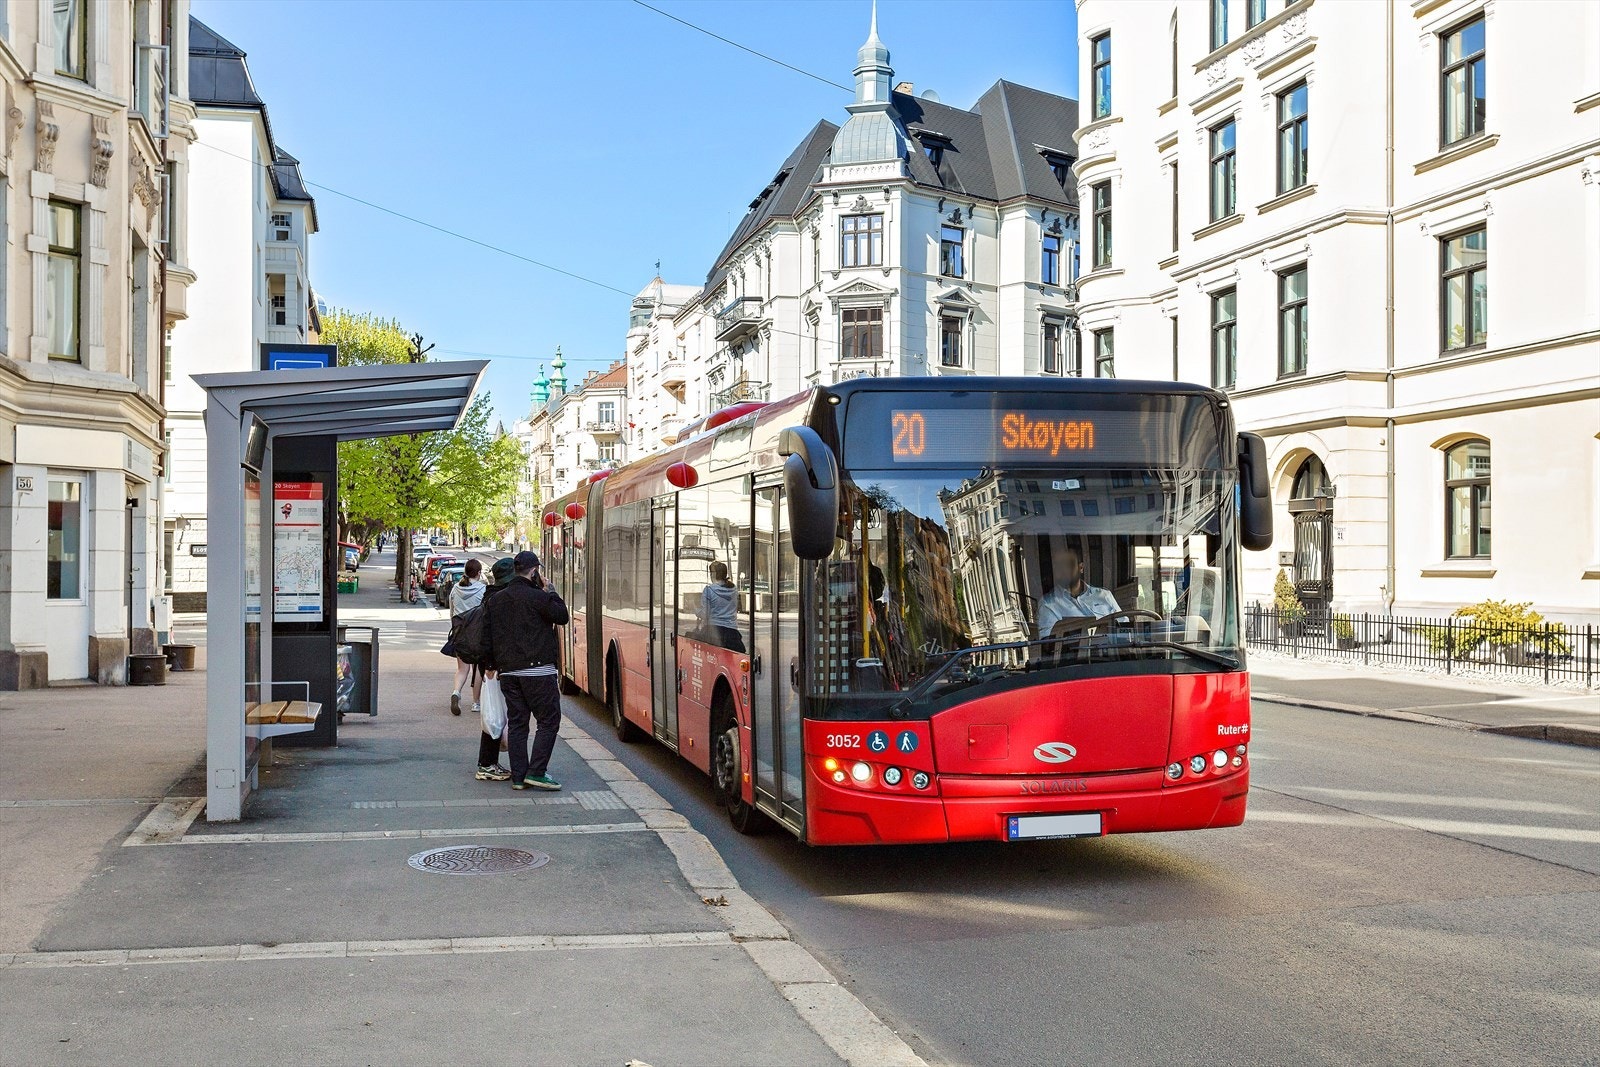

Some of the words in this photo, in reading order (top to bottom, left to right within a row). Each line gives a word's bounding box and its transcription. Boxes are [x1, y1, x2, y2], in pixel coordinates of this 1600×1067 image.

[892, 413, 925, 456] 20
[1001, 413, 1095, 457] Skøyen
[19, 478, 32, 489] 50
[1217, 723, 1249, 736] Ruter#
[826, 734, 861, 748] 3052
[1019, 778, 1088, 795] SOLARIS
